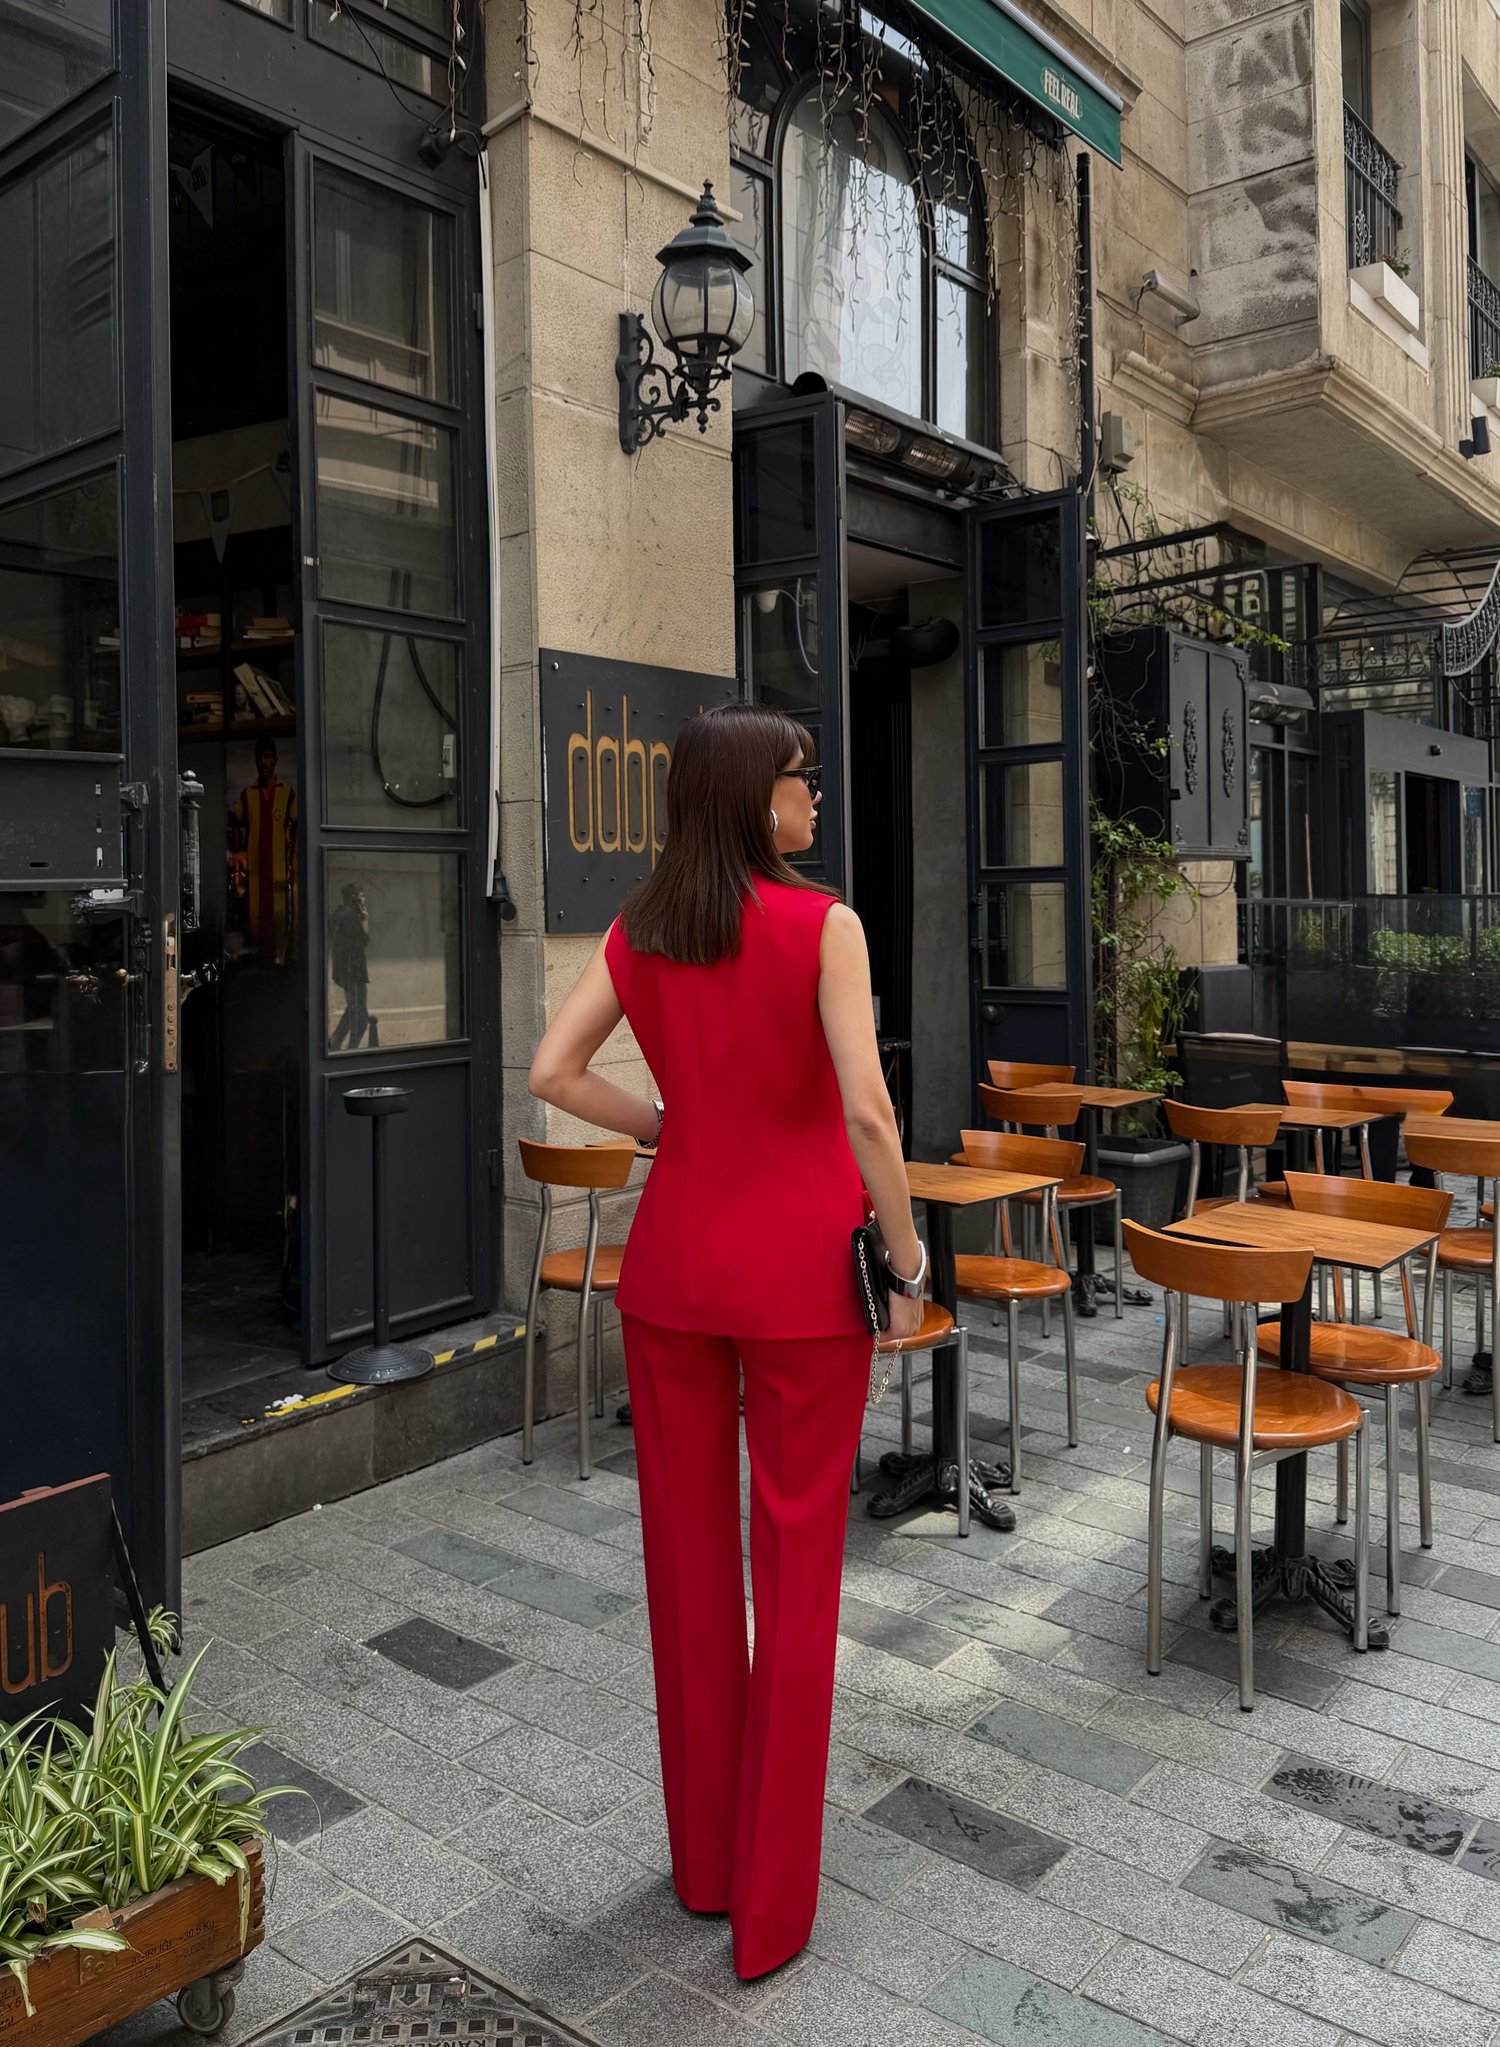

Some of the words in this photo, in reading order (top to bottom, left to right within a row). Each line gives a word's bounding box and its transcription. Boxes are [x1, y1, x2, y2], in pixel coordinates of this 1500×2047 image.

[1043, 68, 1061, 105] FEEL
[1061, 81, 1080, 121] REAL
[567, 688, 704, 874] dabp
